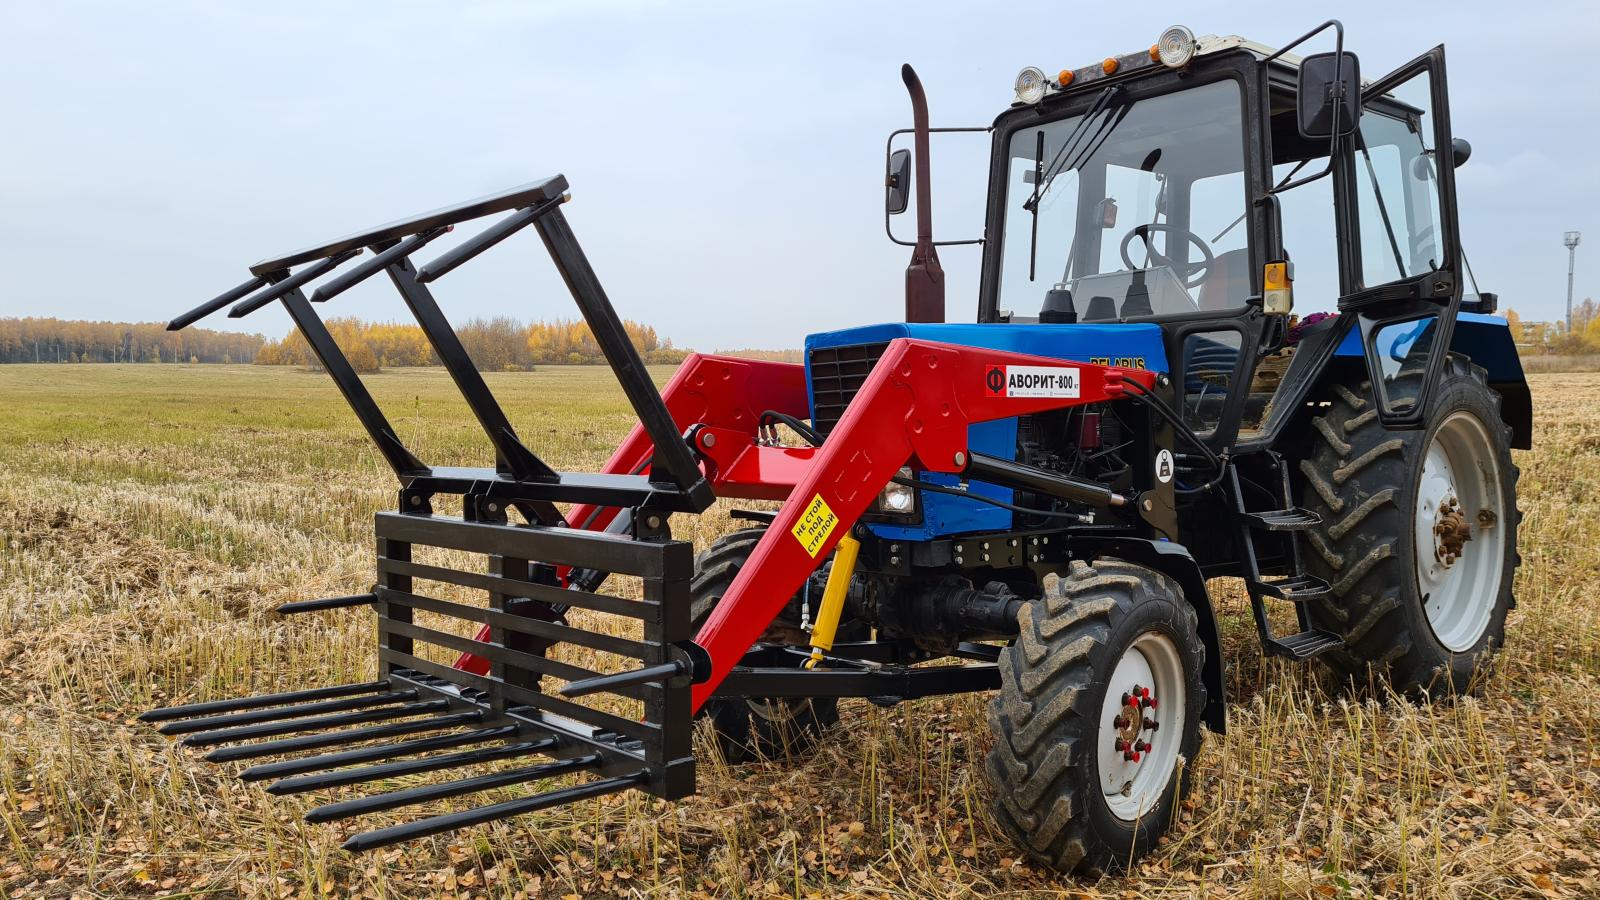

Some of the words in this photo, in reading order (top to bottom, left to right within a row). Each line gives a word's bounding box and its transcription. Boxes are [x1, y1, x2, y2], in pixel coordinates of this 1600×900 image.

[796, 523, 807, 536] НЕ
[805, 499, 823, 523] СТОЙ
[808, 515, 824, 535] ПОД
[808, 512, 835, 553] СТРЕЛОЙ
